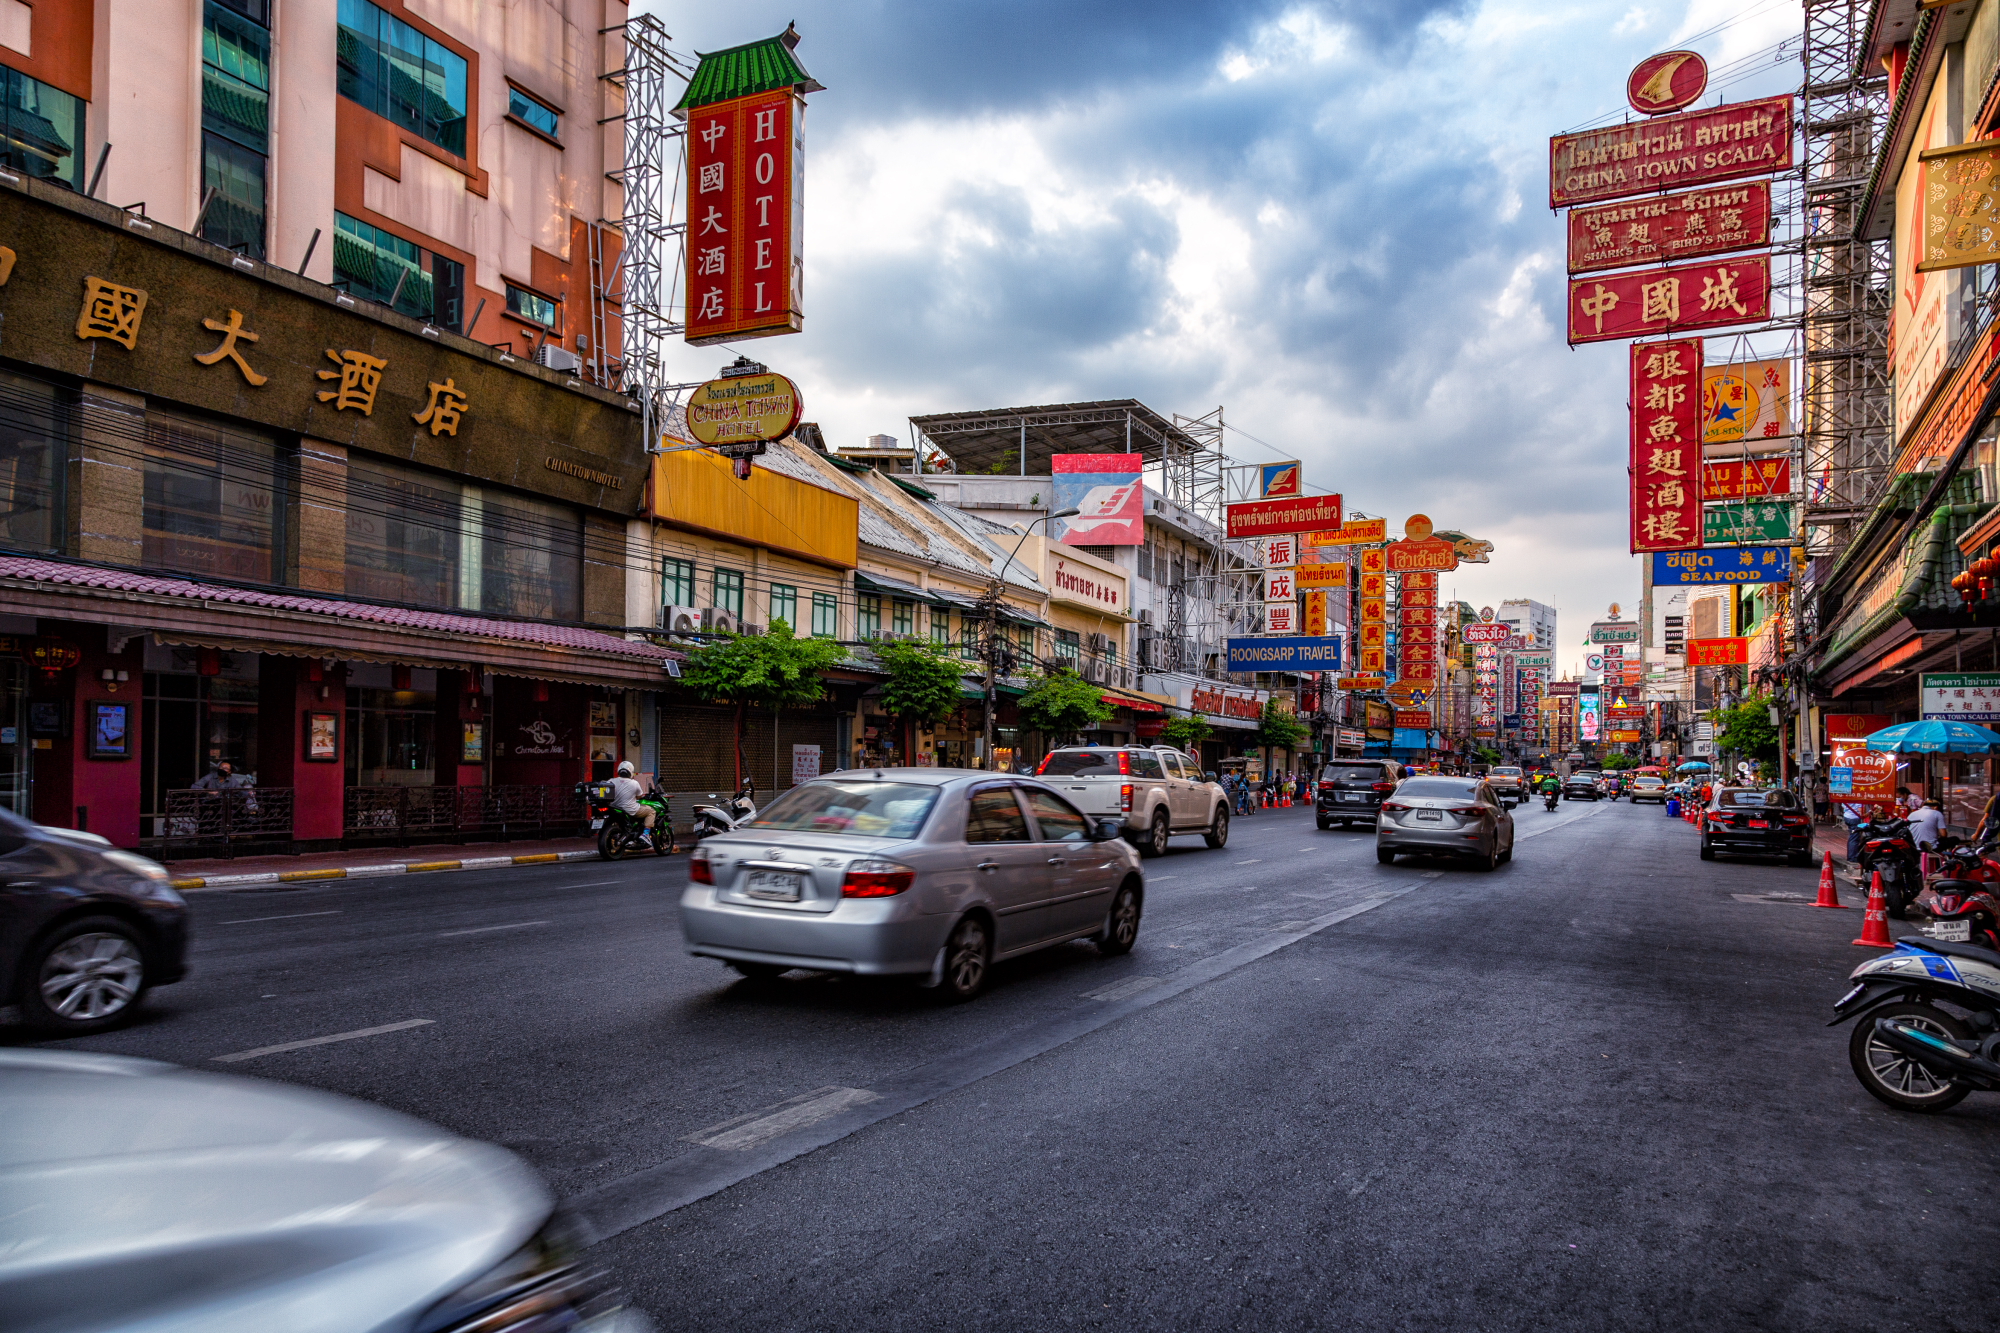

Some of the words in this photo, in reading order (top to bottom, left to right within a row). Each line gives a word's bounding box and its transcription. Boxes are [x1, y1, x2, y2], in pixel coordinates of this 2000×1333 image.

[1564, 168, 1627, 192] CHINA
[1634, 156, 1696, 181] TOWN
[1703, 143, 1776, 169] SCALA
[696, 120, 727, 320] 中國大酒店
[753, 109, 777, 313] HOTEL
[1584, 247, 1634, 262] SHARK'S
[1638, 244, 1657, 256] FIN
[1672, 235, 1714, 250] BIRD'S
[1717, 230, 1749, 243] NEST
[1580, 268, 1747, 334] 中國城
[1899, 336, 1918, 388] CHINA
[1921, 290, 1941, 347] TOWN
[693, 400, 741, 424] CHINA
[745, 395, 790, 418] TOWN
[717, 420, 764, 437] HOTEL
[1641, 350, 1690, 541] 銀都魚翅酒樓
[1704, 485, 1731, 495] ARK
[1736, 483, 1763, 493] FIN
[1296, 566, 1344, 581] กไทยรังนก
[1681, 571, 1762, 582] SEAFOOD
[1739, 550, 1777, 566] 海鮮
[1056, 561, 1094, 598] ห้างขายยา
[1268, 541, 1290, 630] 振成豐
[1407, 574, 1428, 678] 蘇成興大金行
[1468, 627, 1507, 640] ทองใบ
[1231, 647, 1295, 661] ROONGSARP
[1298, 646, 1337, 660] TRAVEL
[1525, 671, 1536, 741] 和成興大金行
[1608, 648, 1618, 729] 和成興行
[1944, 701, 2000, 711] 魚翅酒
